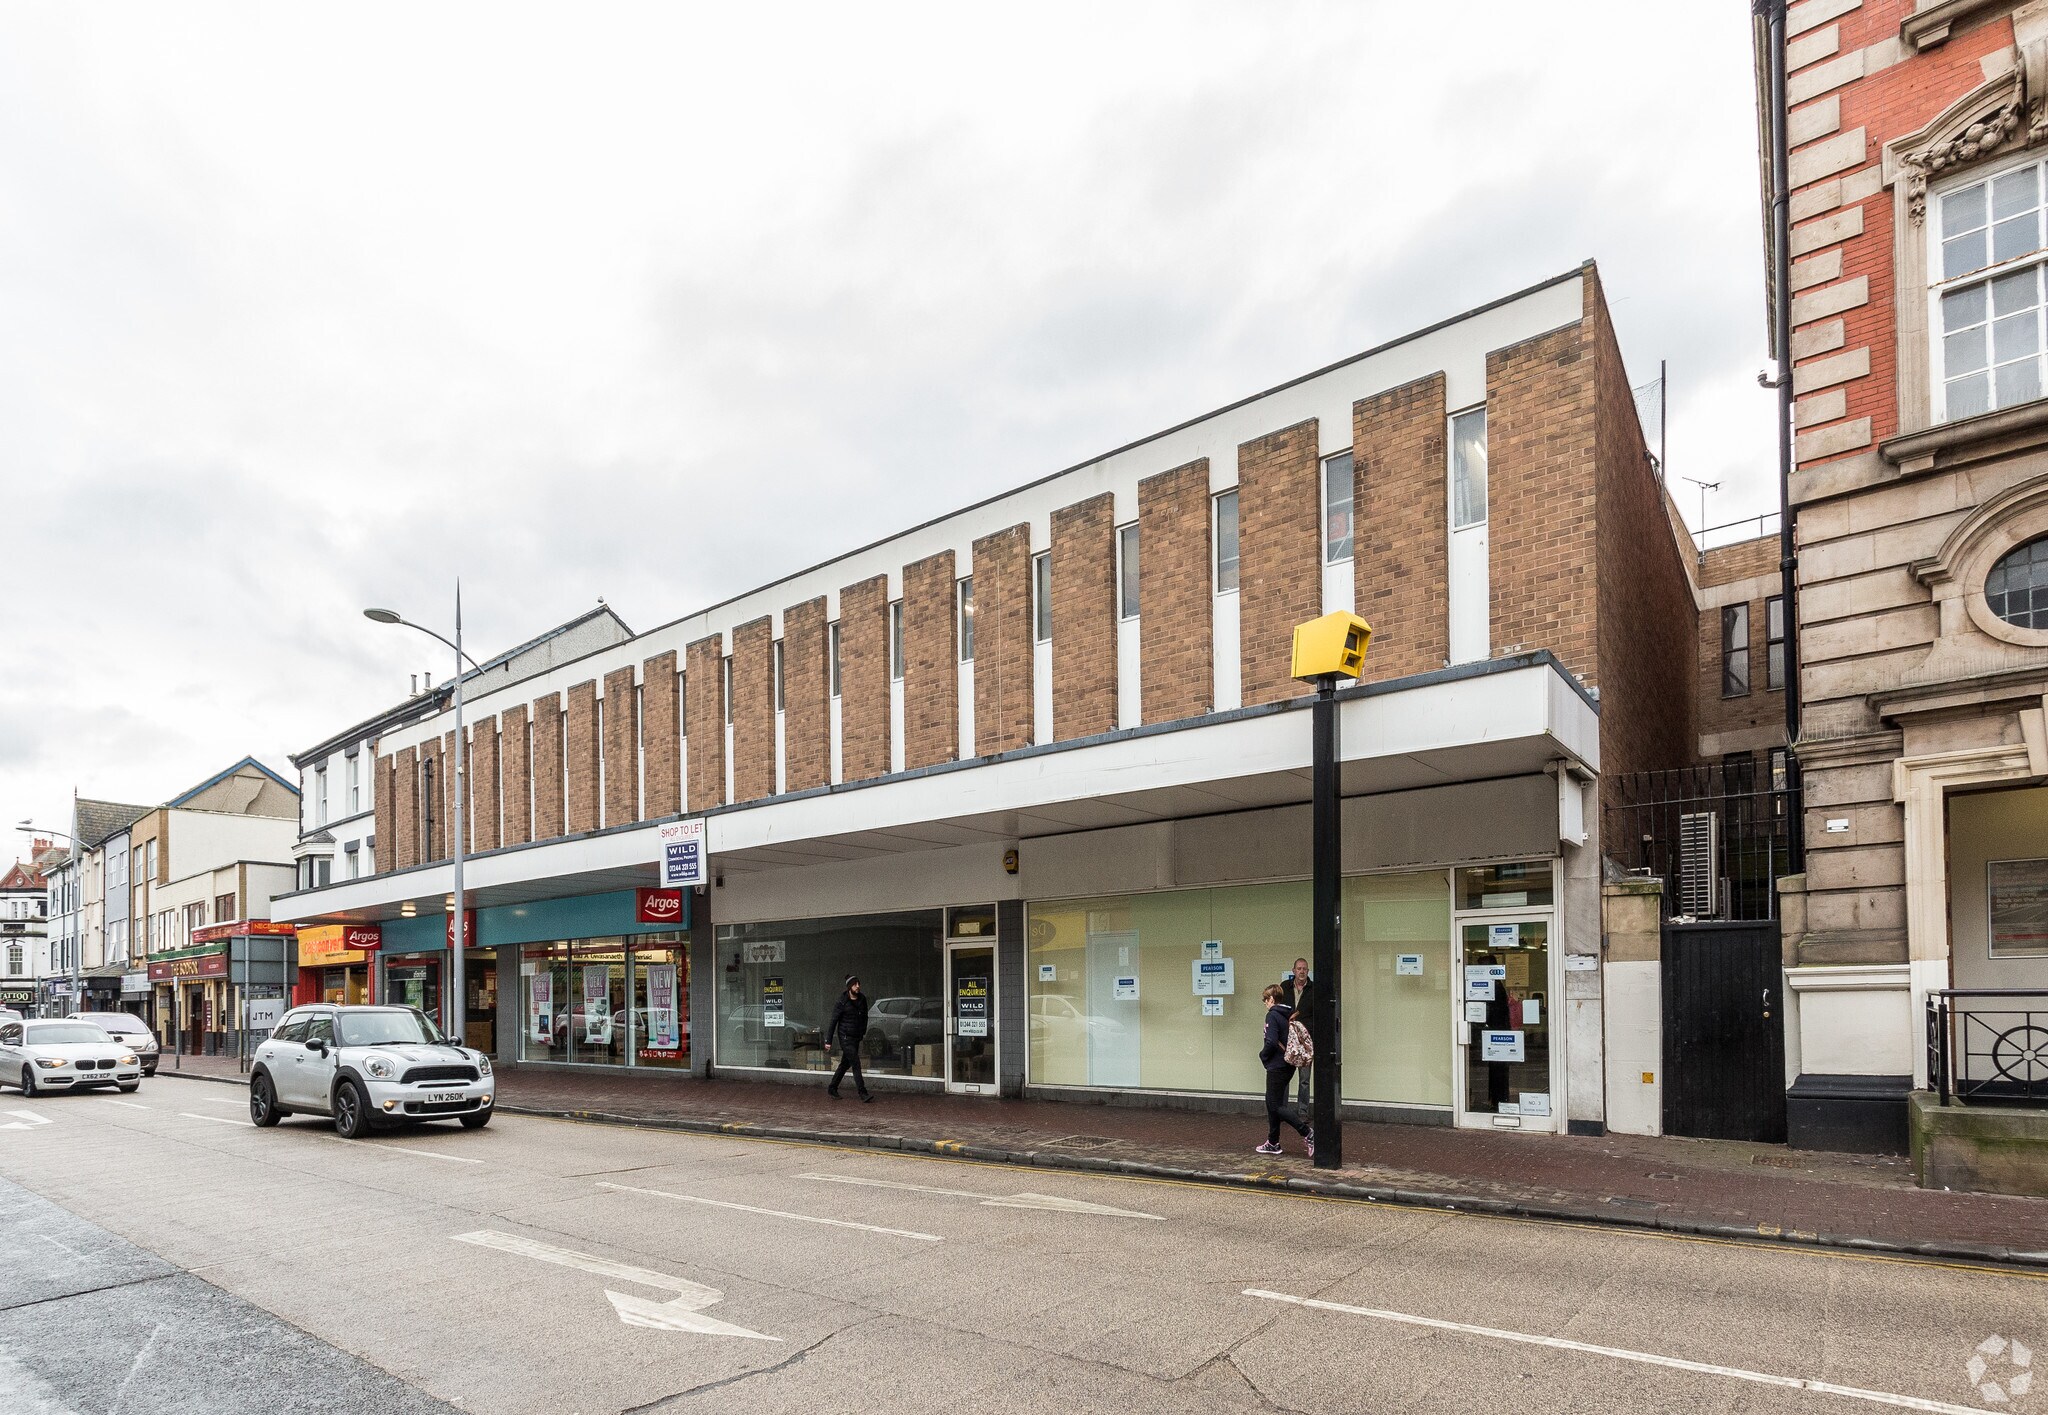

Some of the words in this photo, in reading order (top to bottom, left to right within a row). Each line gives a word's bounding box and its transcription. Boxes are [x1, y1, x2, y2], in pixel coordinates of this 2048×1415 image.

[661, 827, 678, 838] SHOP
[680, 825, 689, 835] TO
[690, 823, 703, 834] LET
[668, 845, 696, 855] WILD
[645, 894, 679, 911] Argos
[349, 931, 379, 943] Argos
[653, 971, 671, 988] NEW
[0, 992, 29, 1001] ATTOO
[960, 988, 986, 996] ENQUIRIES
[253, 1012, 273, 1021] JTM
[428, 1093, 444, 1102] LYN
[445, 1092, 464, 1101] 260K
